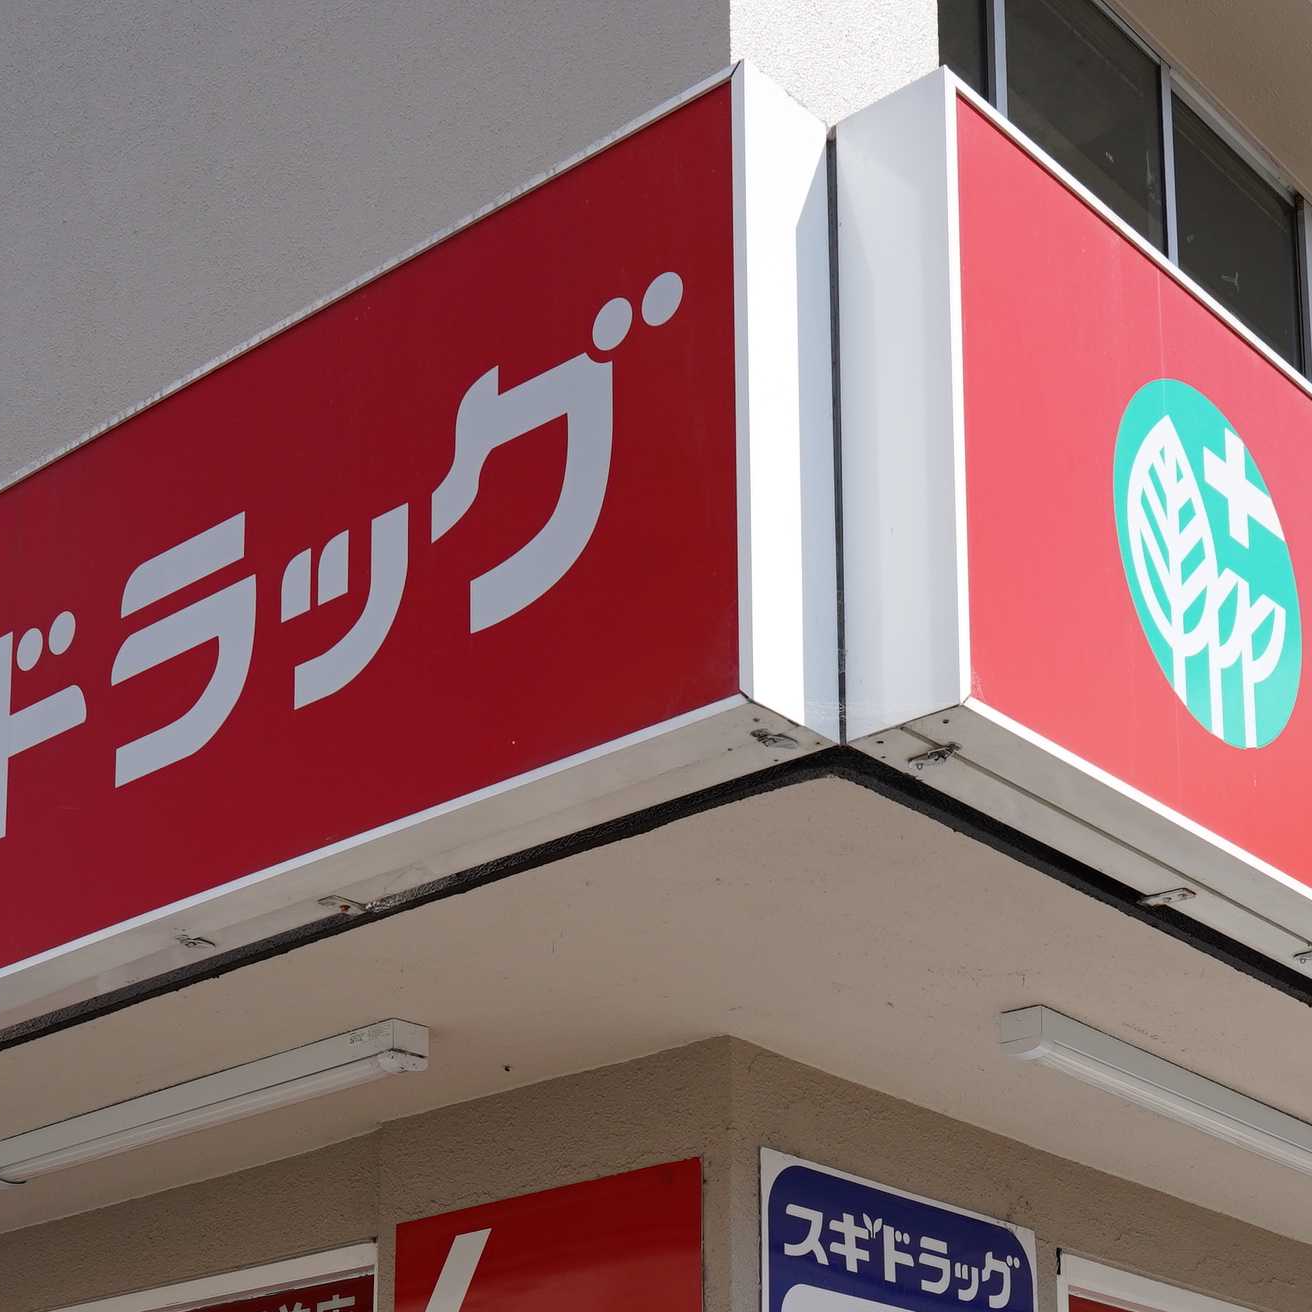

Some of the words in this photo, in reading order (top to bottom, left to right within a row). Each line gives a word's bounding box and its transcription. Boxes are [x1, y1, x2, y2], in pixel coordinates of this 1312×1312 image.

[783, 1202, 1021, 1309] スギドラッグ
